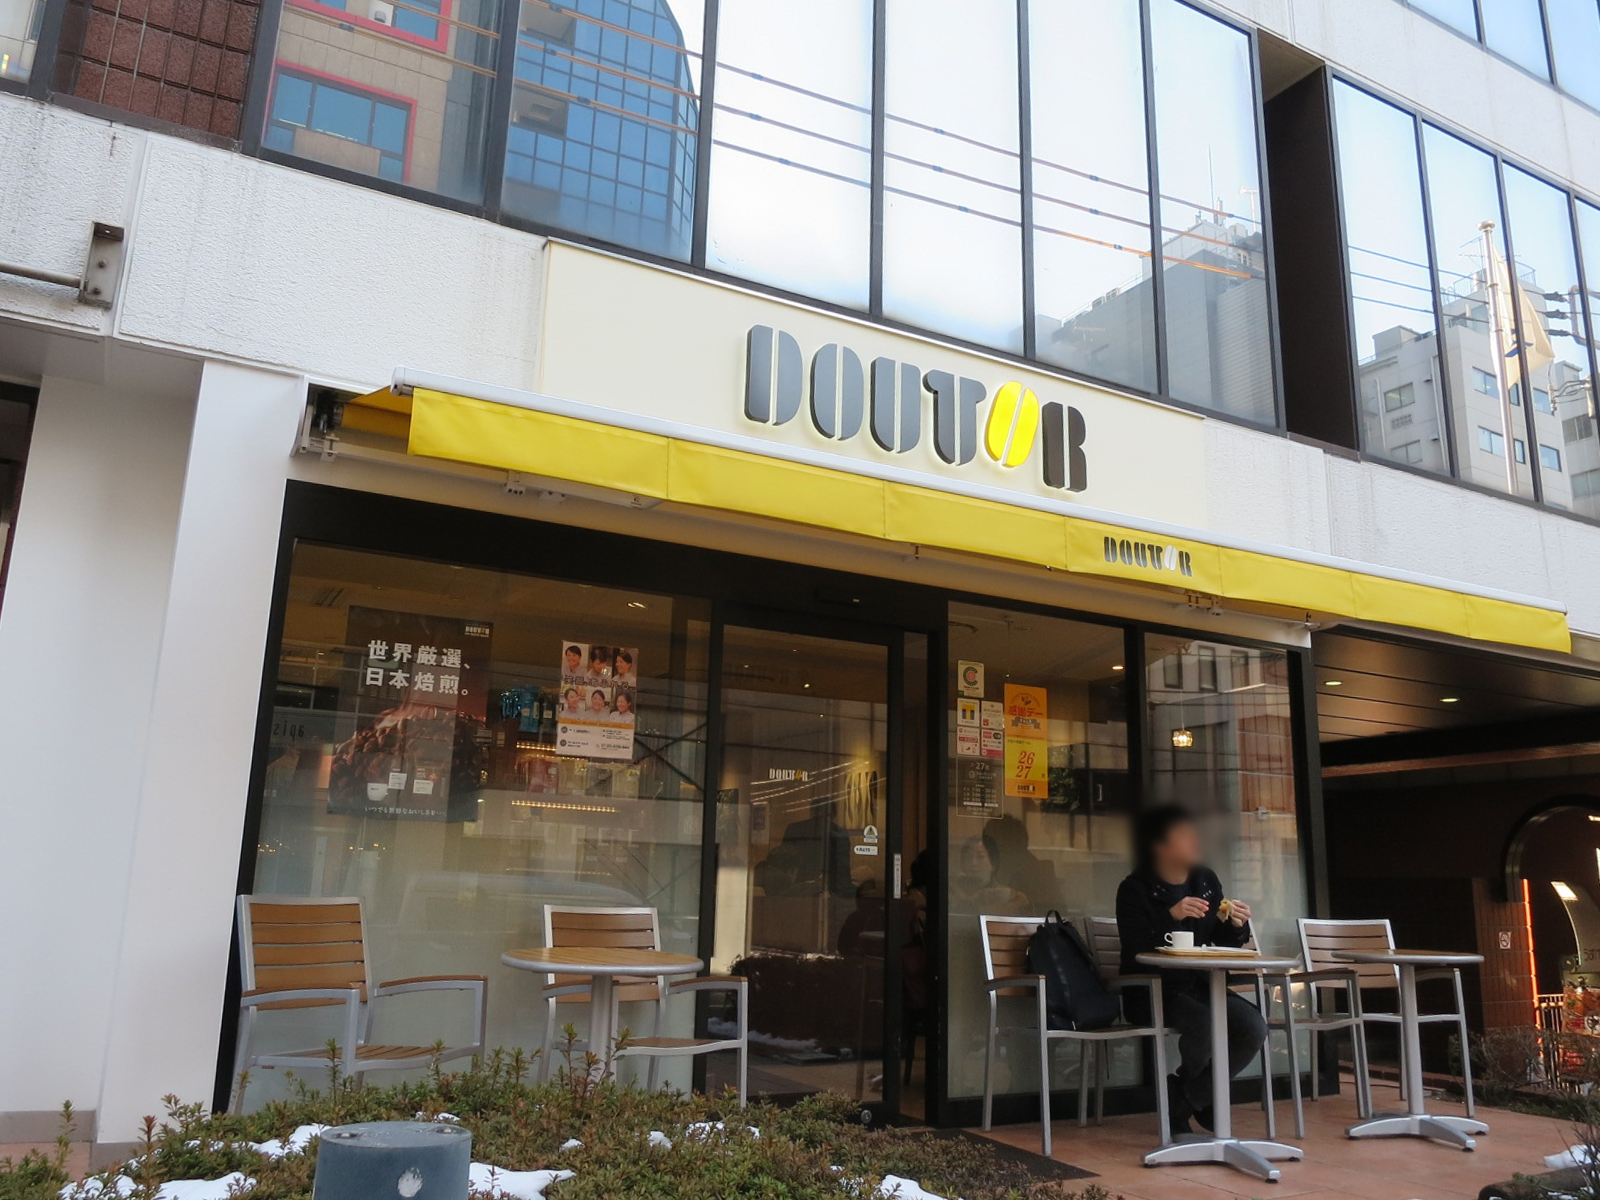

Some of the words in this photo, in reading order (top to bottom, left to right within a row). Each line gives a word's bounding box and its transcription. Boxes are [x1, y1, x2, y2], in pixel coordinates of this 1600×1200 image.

[744, 324, 1088, 492] DOUTOR
[1103, 536, 1193, 577] DOUTOR
[368, 640, 471, 669] 世界厳選、
[365, 667, 469, 696] 日本焙煎。
[1015, 764, 1032, 779] 27
[1018, 750, 1035, 766] 26
[769, 768, 808, 782] DOUTOR
